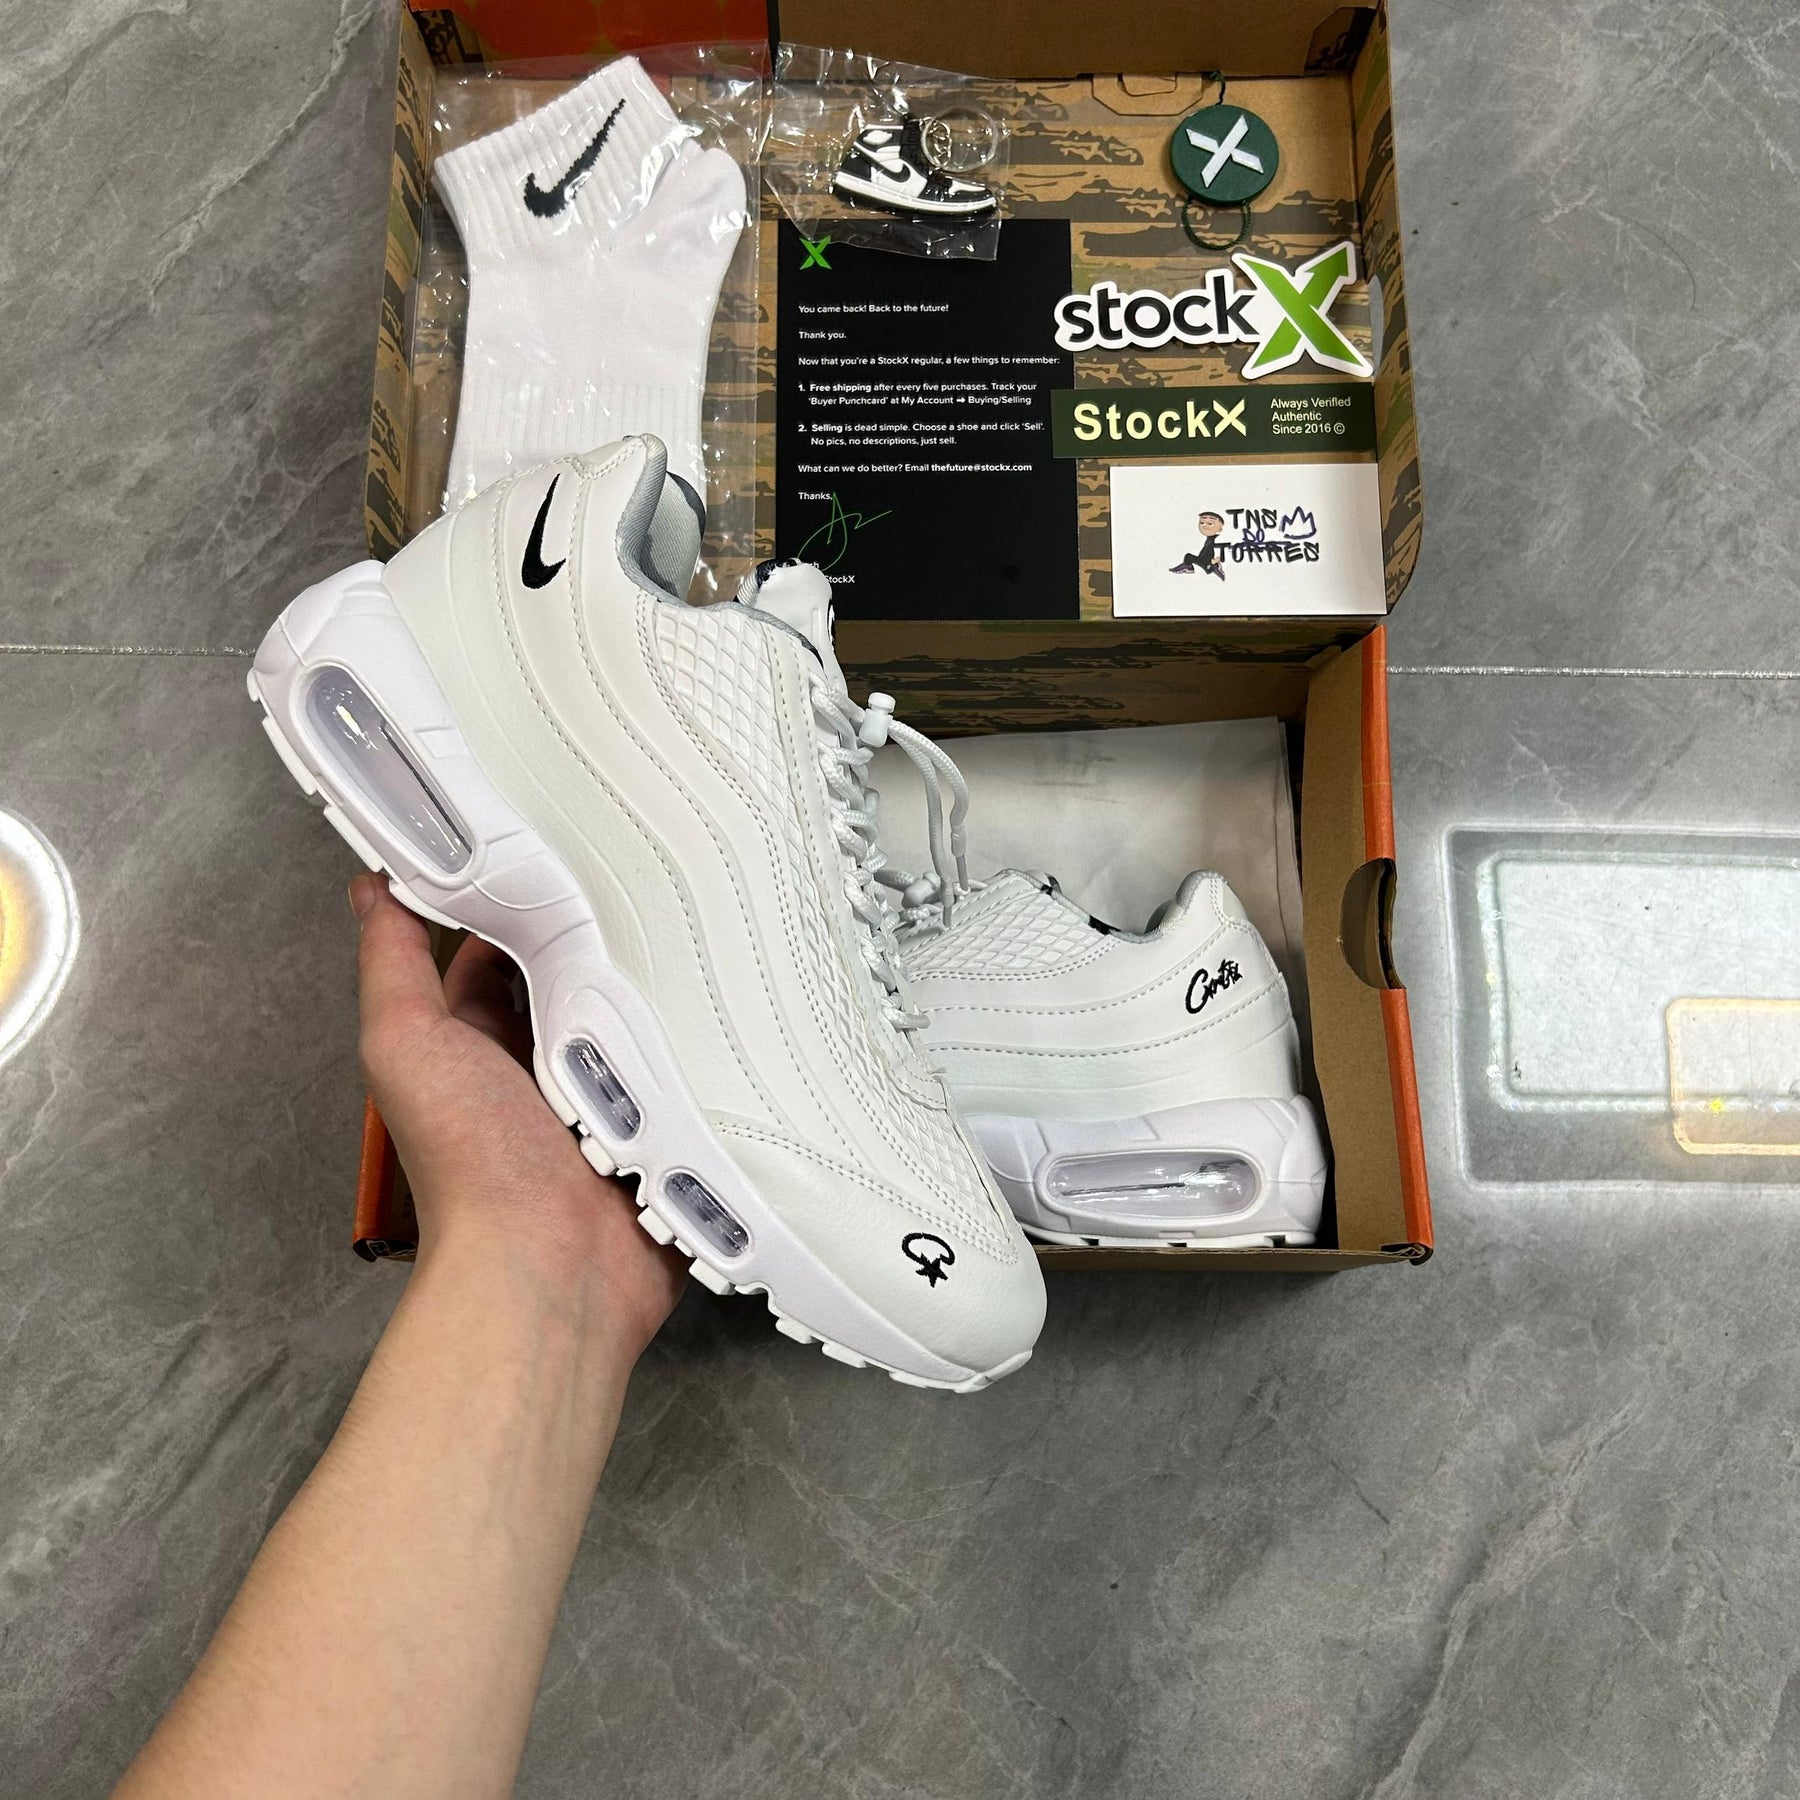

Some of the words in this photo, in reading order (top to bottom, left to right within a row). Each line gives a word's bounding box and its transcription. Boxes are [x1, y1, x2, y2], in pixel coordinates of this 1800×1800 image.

[798, 305, 815, 314] You
[816, 306, 841, 314] came
[842, 304, 866, 313] back!
[868, 304, 890, 313] Back
[892, 305, 902, 313] to
[903, 304, 918, 312] the
[919, 304, 948, 312] future!
[1062, 246, 1365, 371] stockX
[798, 331, 825, 339] Thank
[827, 332, 846, 341] you.
[798, 357, 819, 366] Now
[820, 357, 838, 366] that
[869, 357, 875, 365] a
[877, 356, 908, 365] StockX
[910, 356, 943, 367] regular,
[945, 357, 951, 365] a
[953, 355, 970, 365] few
[971, 356, 999, 366] things
[1000, 356, 1010, 364] to
[1011, 356, 1059, 365] remember:
[797, 383, 805, 392] 1.
[809, 383, 830, 392] Free
[832, 383, 871, 393] shipping
[873, 382, 893, 392] after
[895, 384, 921, 393] every
[922, 382, 938, 391] five
[940, 382, 988, 393] purchases.
[990, 382, 1014, 391] Track
[1016, 384, 1037, 393] your
[890, 397, 899, 405] at
[901, 396, 915, 406] My
[916, 396, 953, 405] Account
[1270, 398, 1309, 410] Always
[1310, 396, 1351, 407] Verified
[1073, 397, 1247, 440] StockX
[1271, 411, 1322, 421] Authentic
[797, 423, 807, 433] 2.
[811, 423, 842, 434] Selling
[844, 423, 852, 432] is
[853, 423, 877, 432] dead
[878, 423, 910, 433] simple.
[912, 422, 947, 432] Choose
[956, 422, 978, 431] shoe
[980, 422, 997, 431] and
[999, 422, 1020, 431] click
[1272, 424, 1303, 434] Since
[1304, 423, 1332, 433] 2016
[810, 437, 824, 446] No
[826, 437, 846, 447] pics,
[862, 436, 919, 447] descriptions,
[920, 436, 937, 447] just
[938, 436, 956, 445] sell.
[797, 464, 821, 473] What
[823, 465, 839, 473] can
[841, 465, 855, 473] we
[856, 464, 869, 473] do
[871, 463, 903, 472] better?
[904, 463, 929, 472] Email
[797, 491, 833, 501] Thanks,
[1225, 508, 1277, 529] TNS
